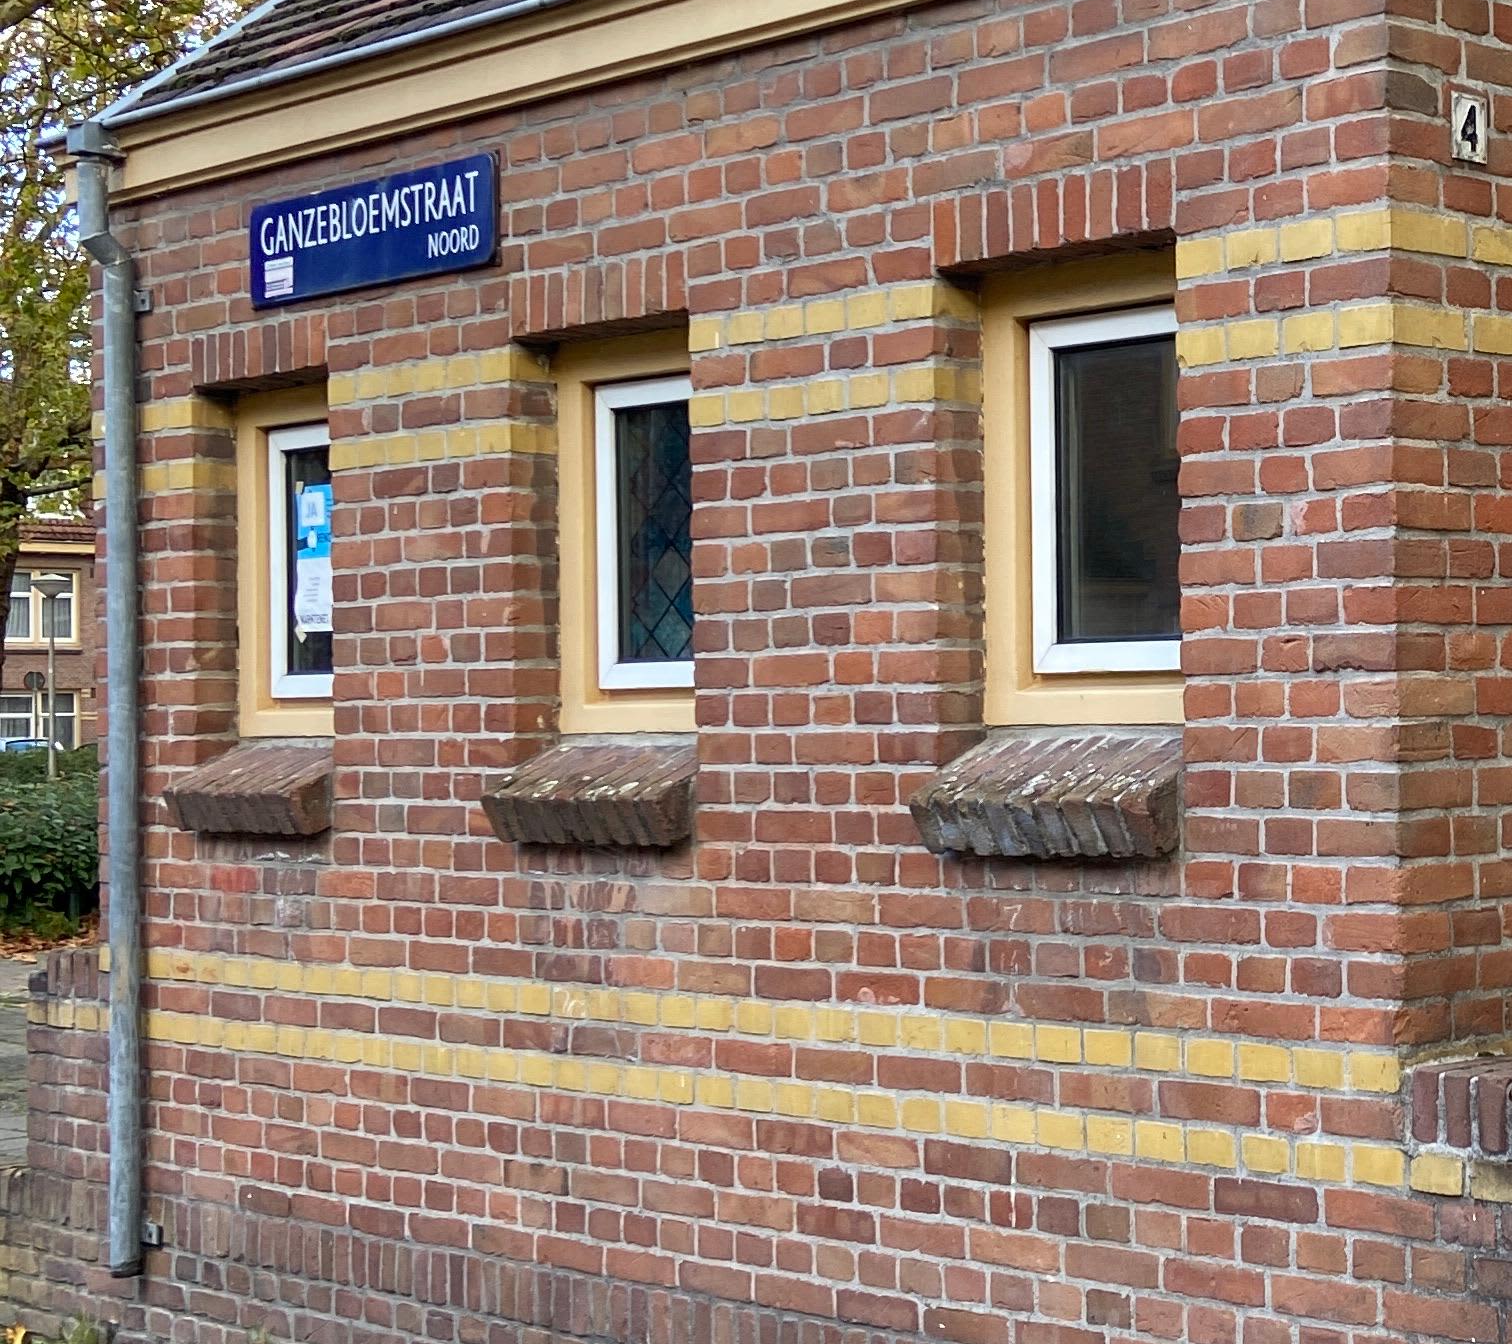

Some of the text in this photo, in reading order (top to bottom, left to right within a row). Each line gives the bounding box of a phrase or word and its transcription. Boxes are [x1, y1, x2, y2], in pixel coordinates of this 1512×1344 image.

[1460, 104, 1479, 153] 4
[260, 170, 479, 256] GANZEBLOEMSTRAAT
[427, 224, 480, 259] NOORD
